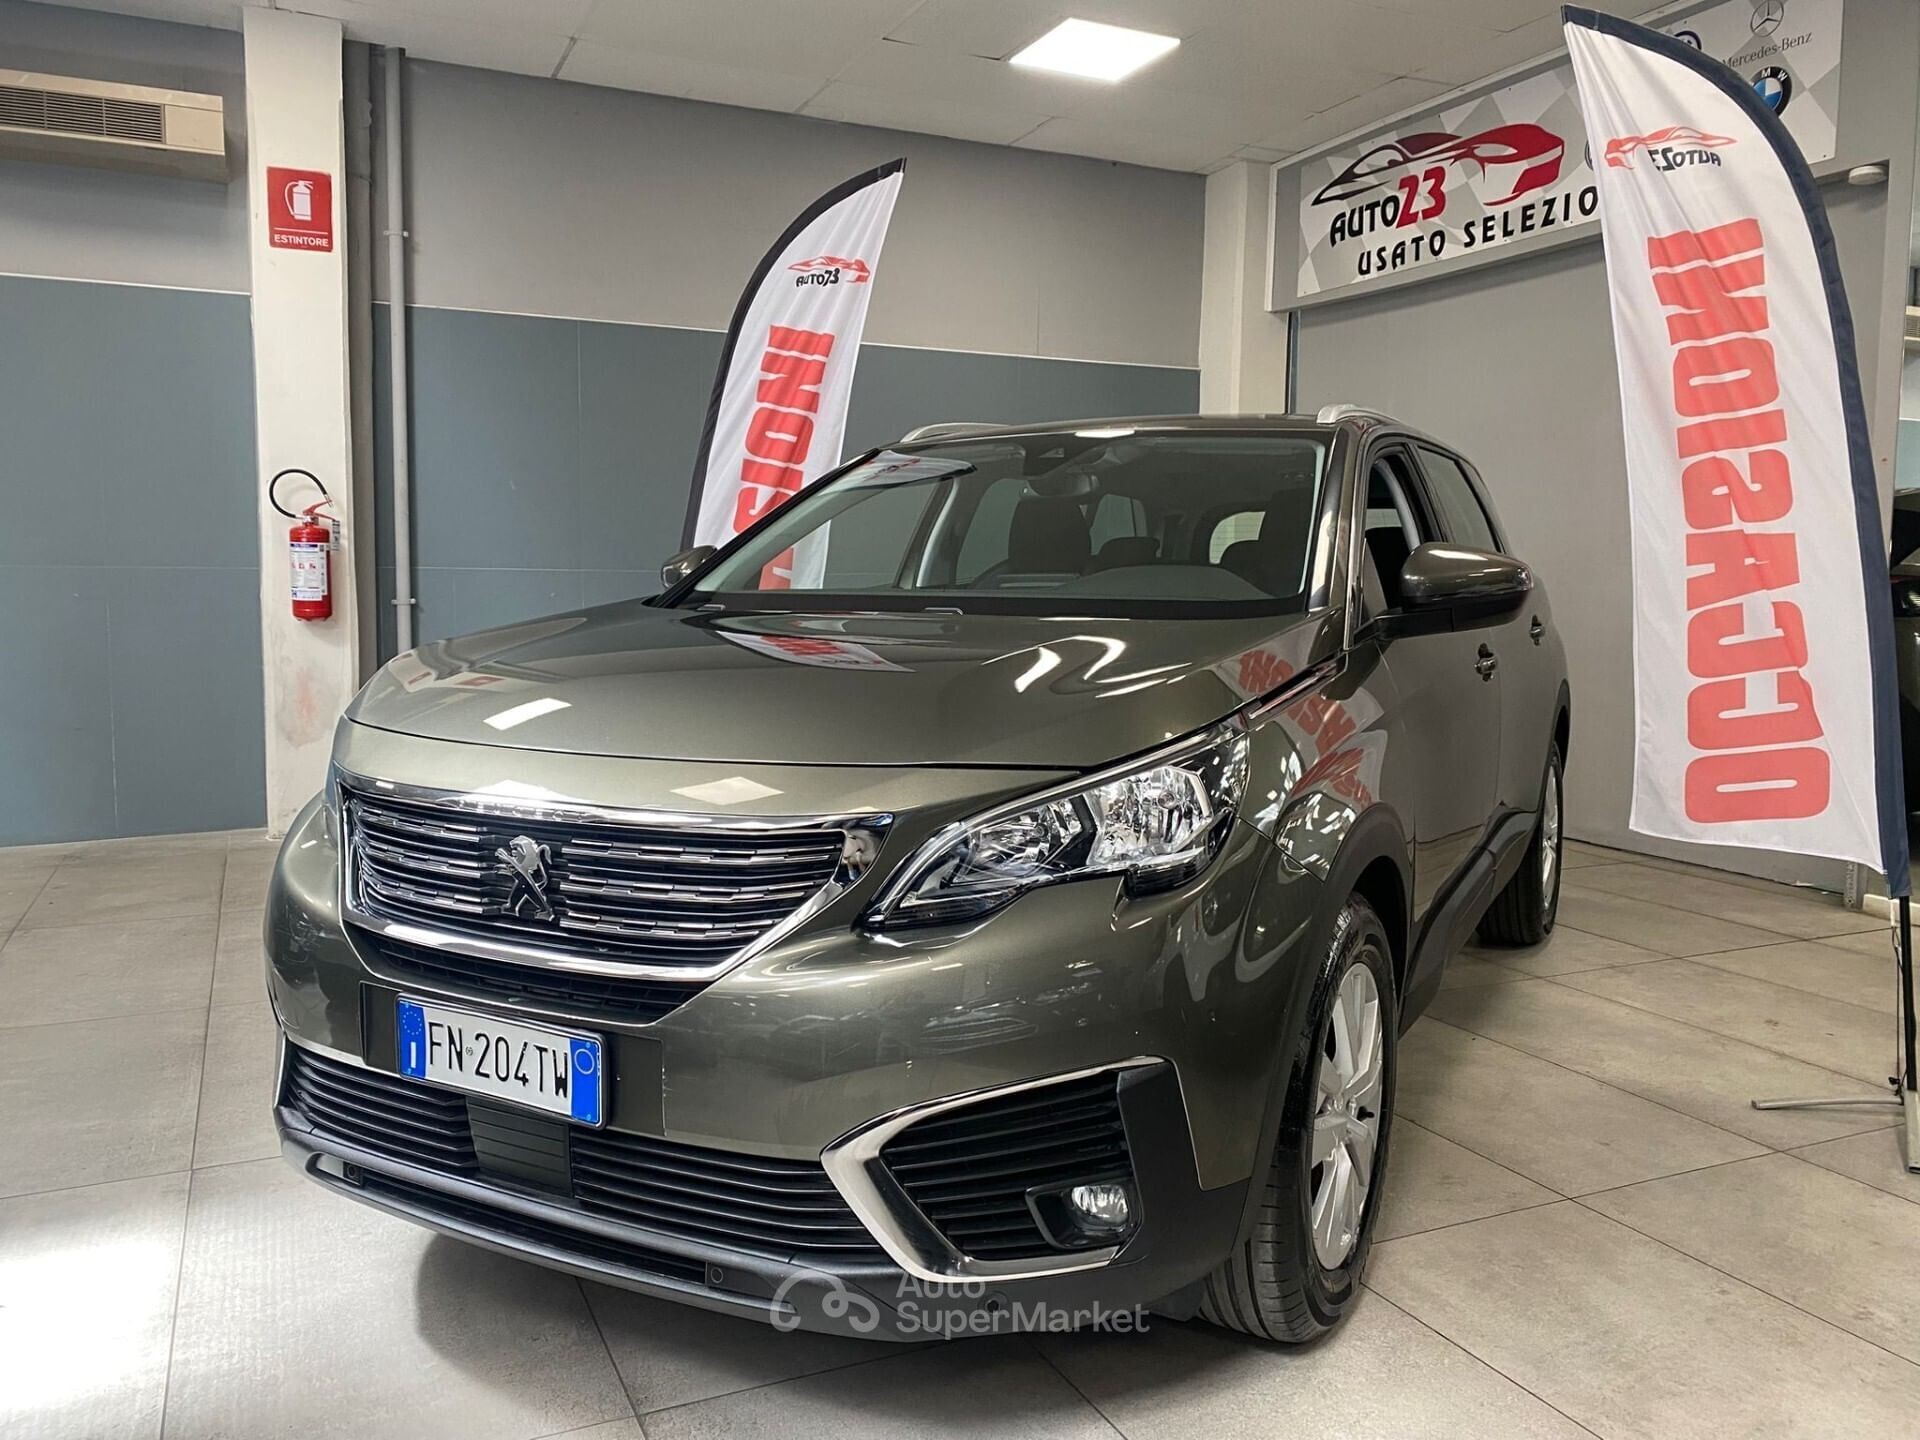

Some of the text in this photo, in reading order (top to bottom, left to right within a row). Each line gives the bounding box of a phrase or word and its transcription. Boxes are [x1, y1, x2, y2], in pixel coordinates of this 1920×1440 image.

[274, 234, 329, 247] ESTINTORE
[1329, 166, 1447, 248] AUTO23
[1358, 186, 1599, 276] USATO SELEZIO
